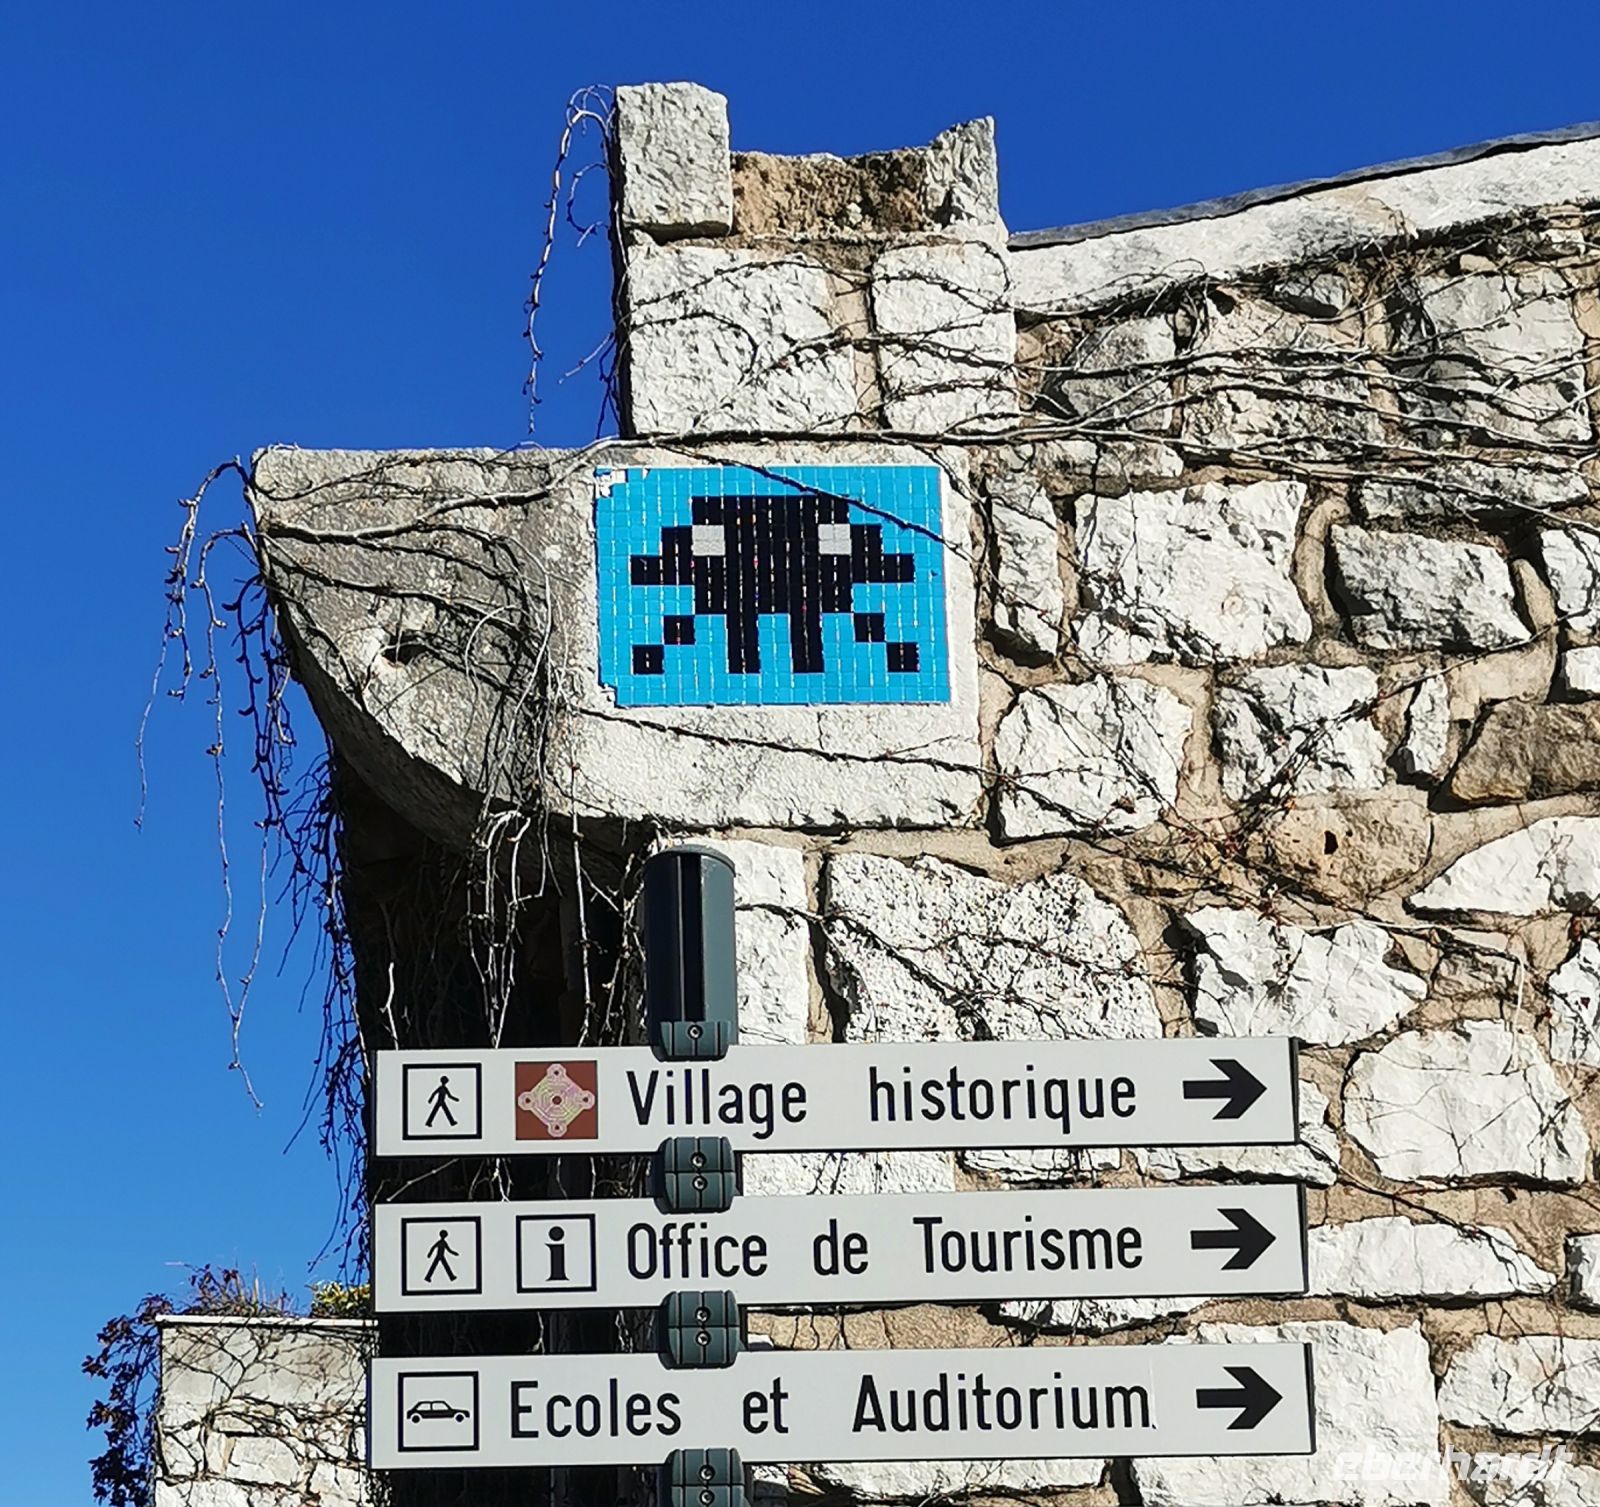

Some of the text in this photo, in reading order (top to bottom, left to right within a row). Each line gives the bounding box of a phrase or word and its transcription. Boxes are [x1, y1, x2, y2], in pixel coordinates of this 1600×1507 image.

[626, 1065, 1136, 1139] Village historique
[627, 1216, 1143, 1280] Office de Tourisme
[510, 1372, 1151, 1439] Ecoles et Auditorium
